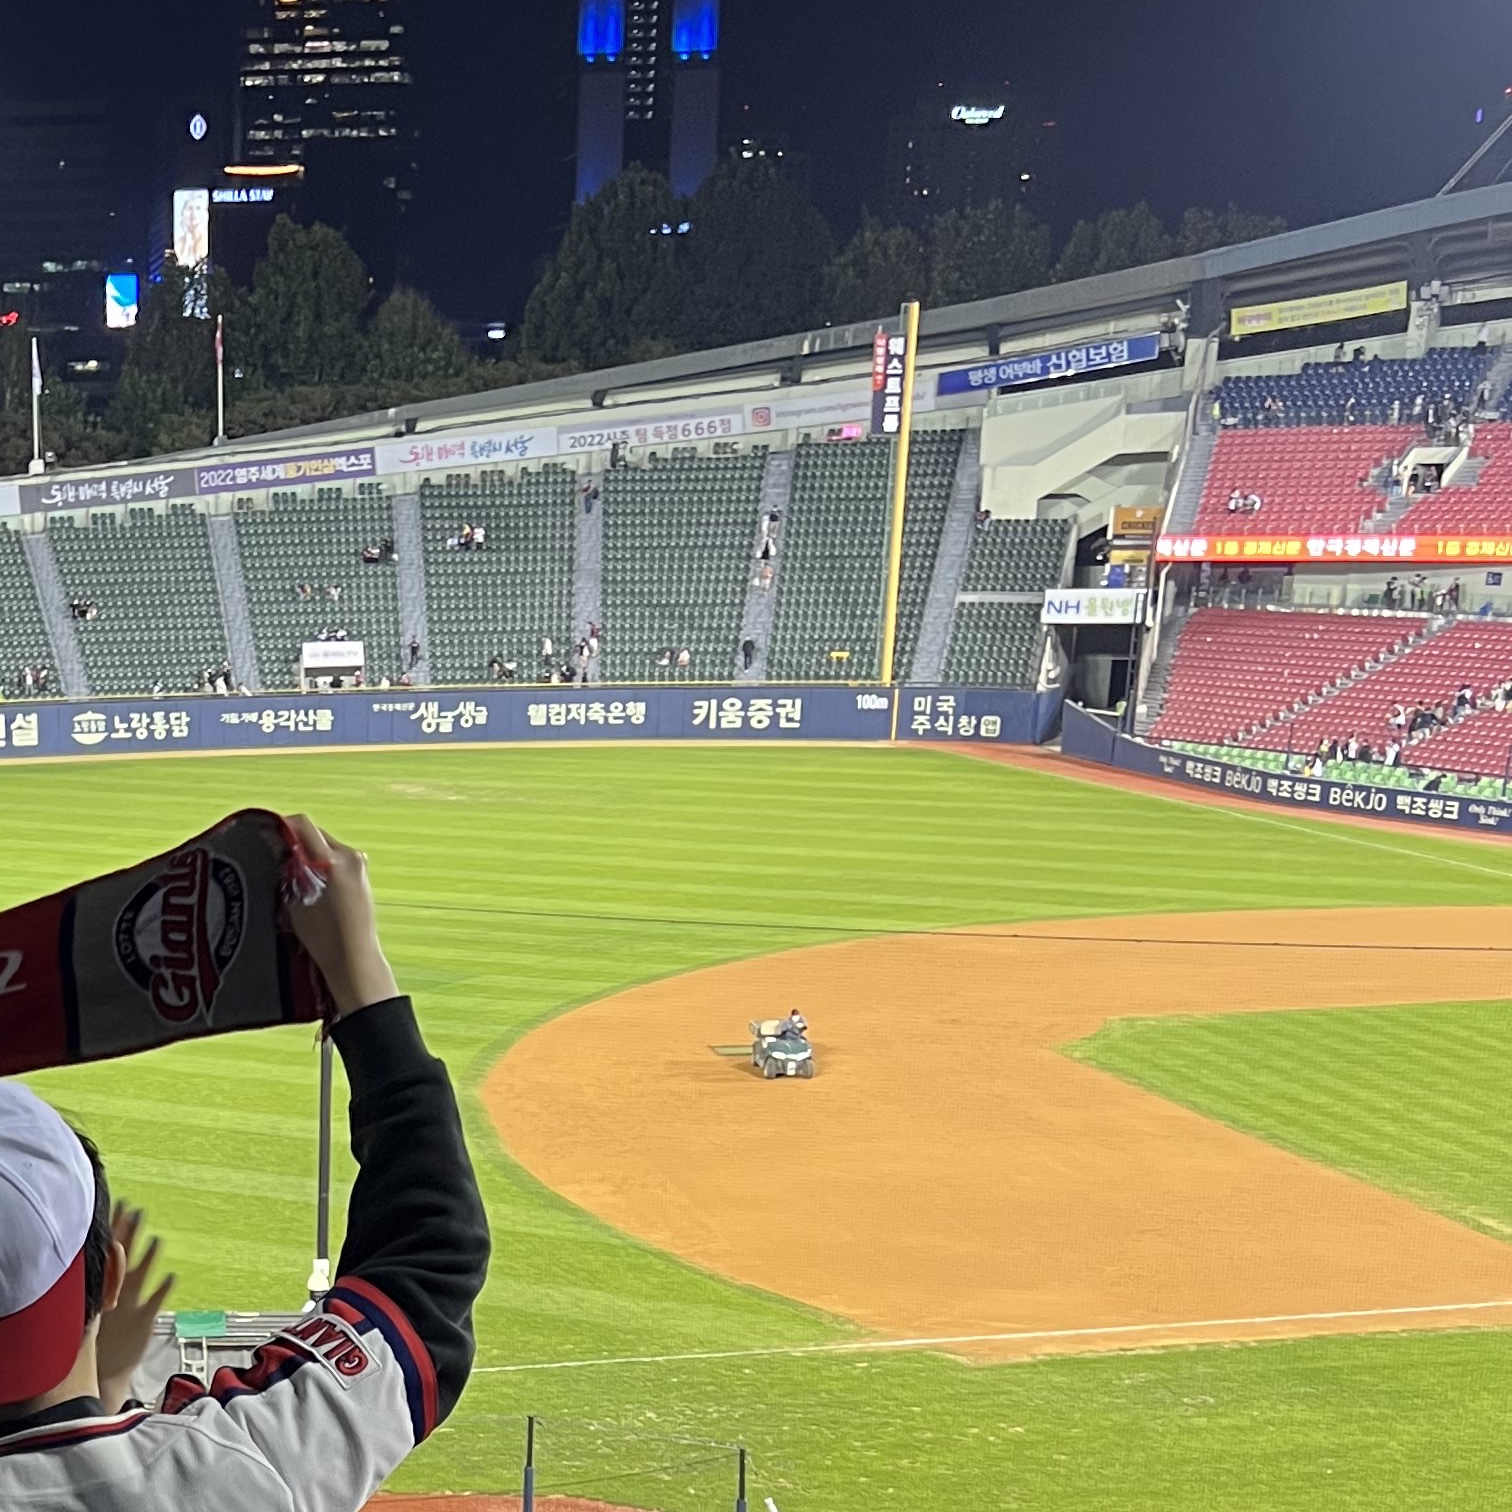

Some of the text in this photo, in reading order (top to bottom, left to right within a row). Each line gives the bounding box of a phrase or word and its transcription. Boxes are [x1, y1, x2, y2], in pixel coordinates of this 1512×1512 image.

[968, 367, 996, 387] 평생
[1048, 340, 1129, 376] 신협보험
[1306, 538, 1416, 557] 한국경제신문
[1047, 600, 1081, 615] NH
[527, 701, 646, 726] 웰컴저축은행
[692, 697, 802, 729] 키움증권
[856, 694, 888, 710] 100m
[913, 695, 957, 715] 미국
[259, 709, 334, 732] 용각산쿨
[410, 701, 488, 733] 생글생글
[911, 715, 977, 736] 주식창
[1396, 795, 1459, 820] 백조씽크
